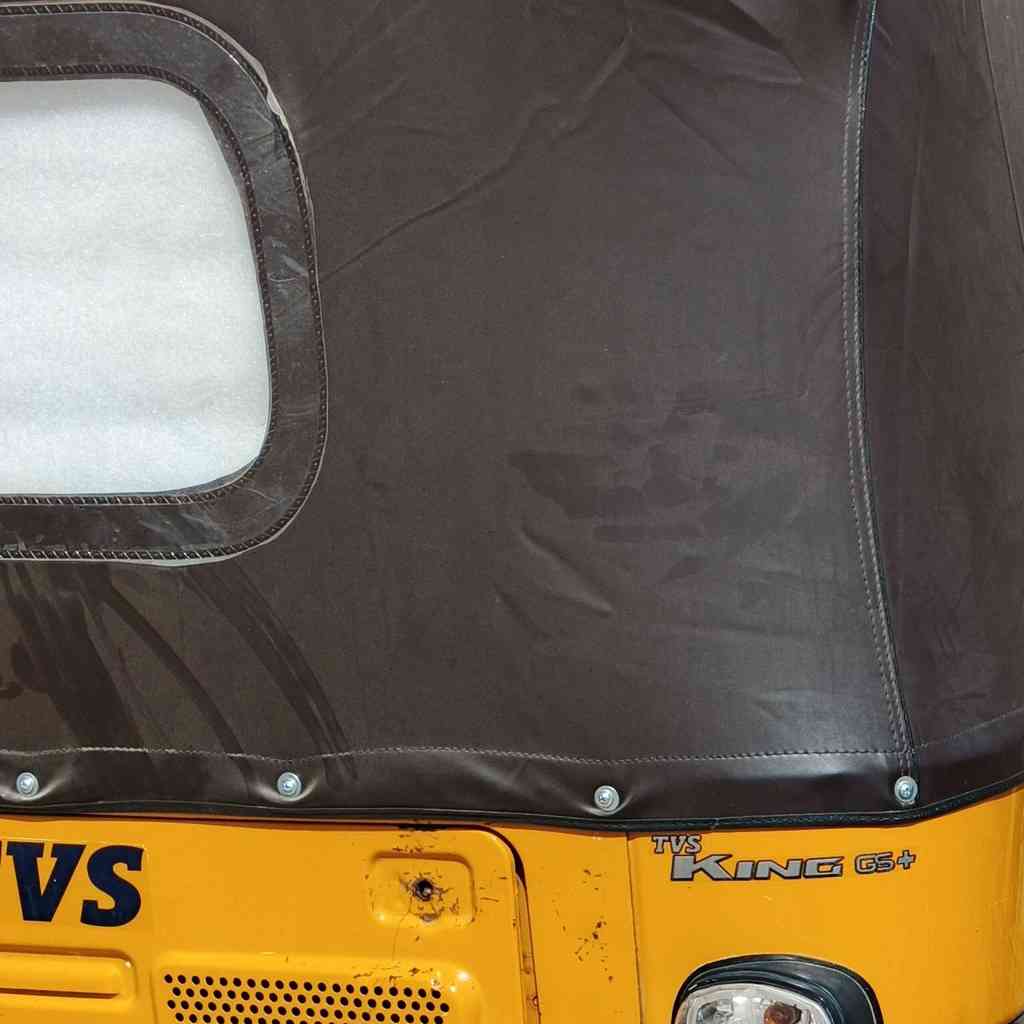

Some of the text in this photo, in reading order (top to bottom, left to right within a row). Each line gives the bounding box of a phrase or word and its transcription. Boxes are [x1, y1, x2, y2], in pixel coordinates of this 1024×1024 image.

[652, 834, 702, 854] TVS
[670, 853, 845, 881] KING
[0, 840, 145, 927] VS
